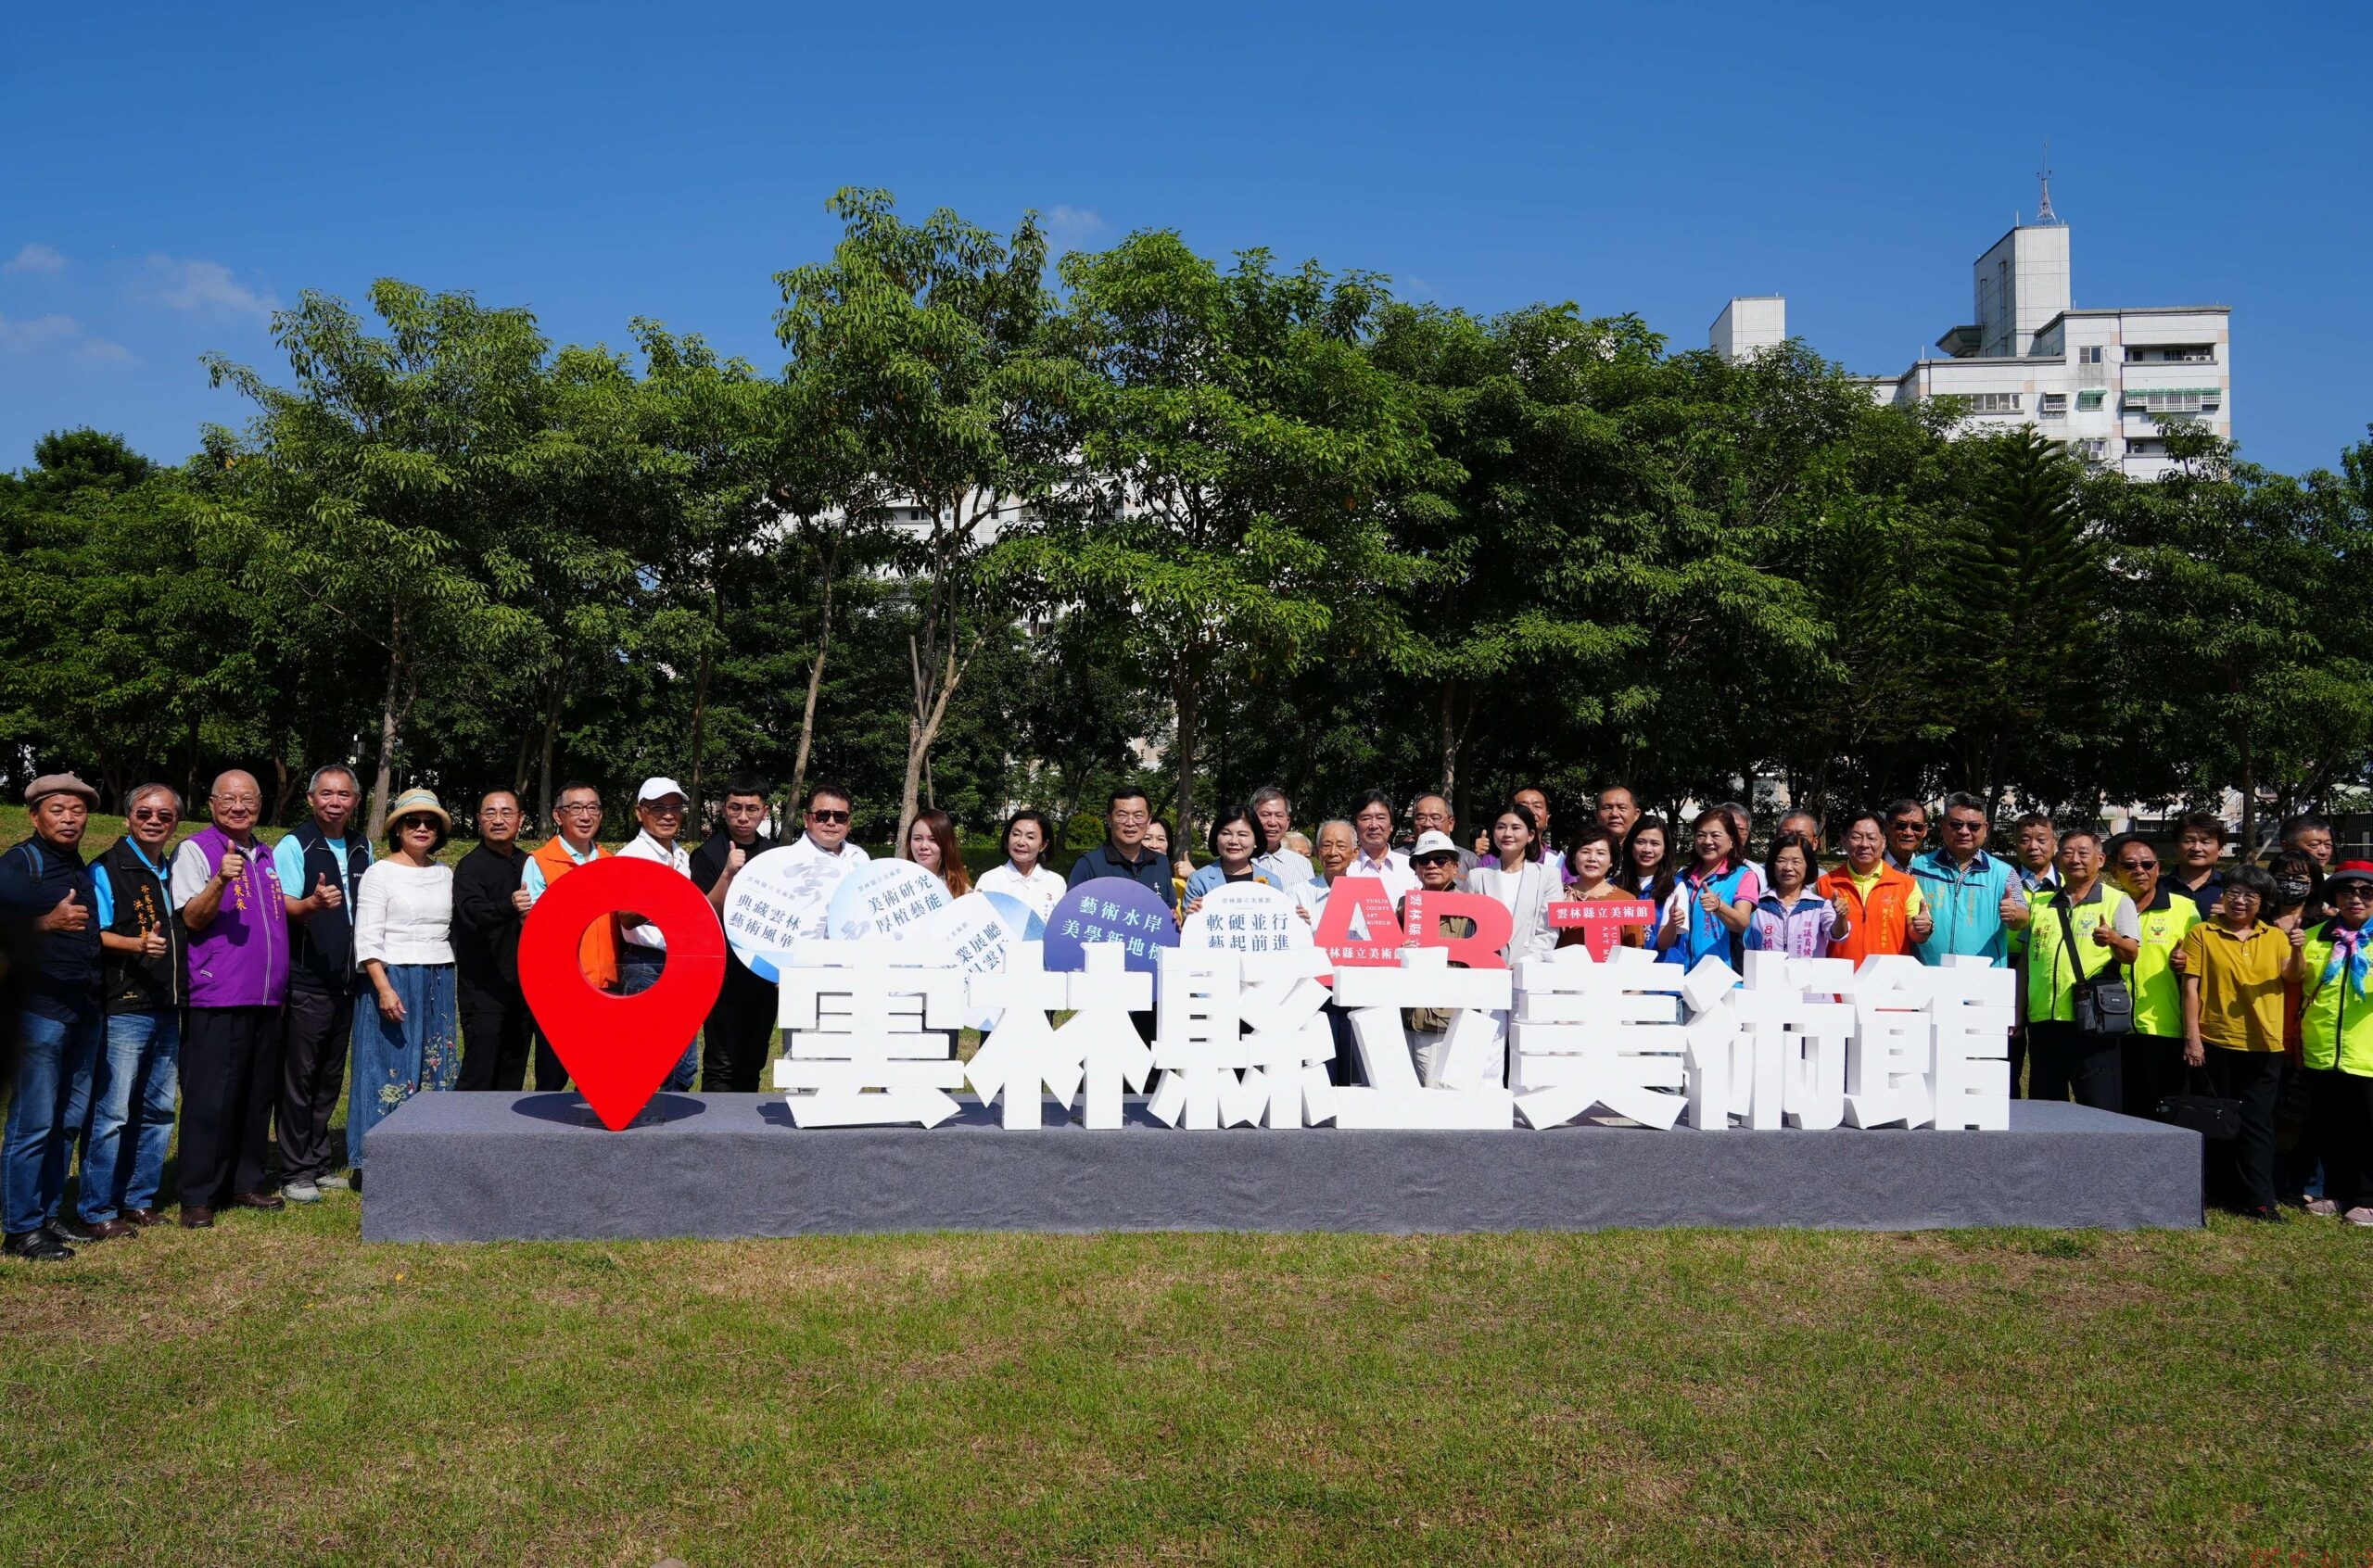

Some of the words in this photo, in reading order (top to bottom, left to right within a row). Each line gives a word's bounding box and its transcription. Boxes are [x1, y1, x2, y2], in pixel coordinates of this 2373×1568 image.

[736, 893, 803, 931] 典藏雲林
[868, 875, 933, 916] 美術研究
[875, 892, 943, 934] 厚植藝能
[1079, 895, 1162, 933] 藝術水岸
[1555, 905, 1648, 920] 雲林縣立美術館
[728, 911, 795, 949] 藝術風華
[1206, 914, 1289, 931] 軟硬並行
[1208, 934, 1289, 952] 藝起前進
[773, 939, 2016, 1132] 雲林縣立美術館
